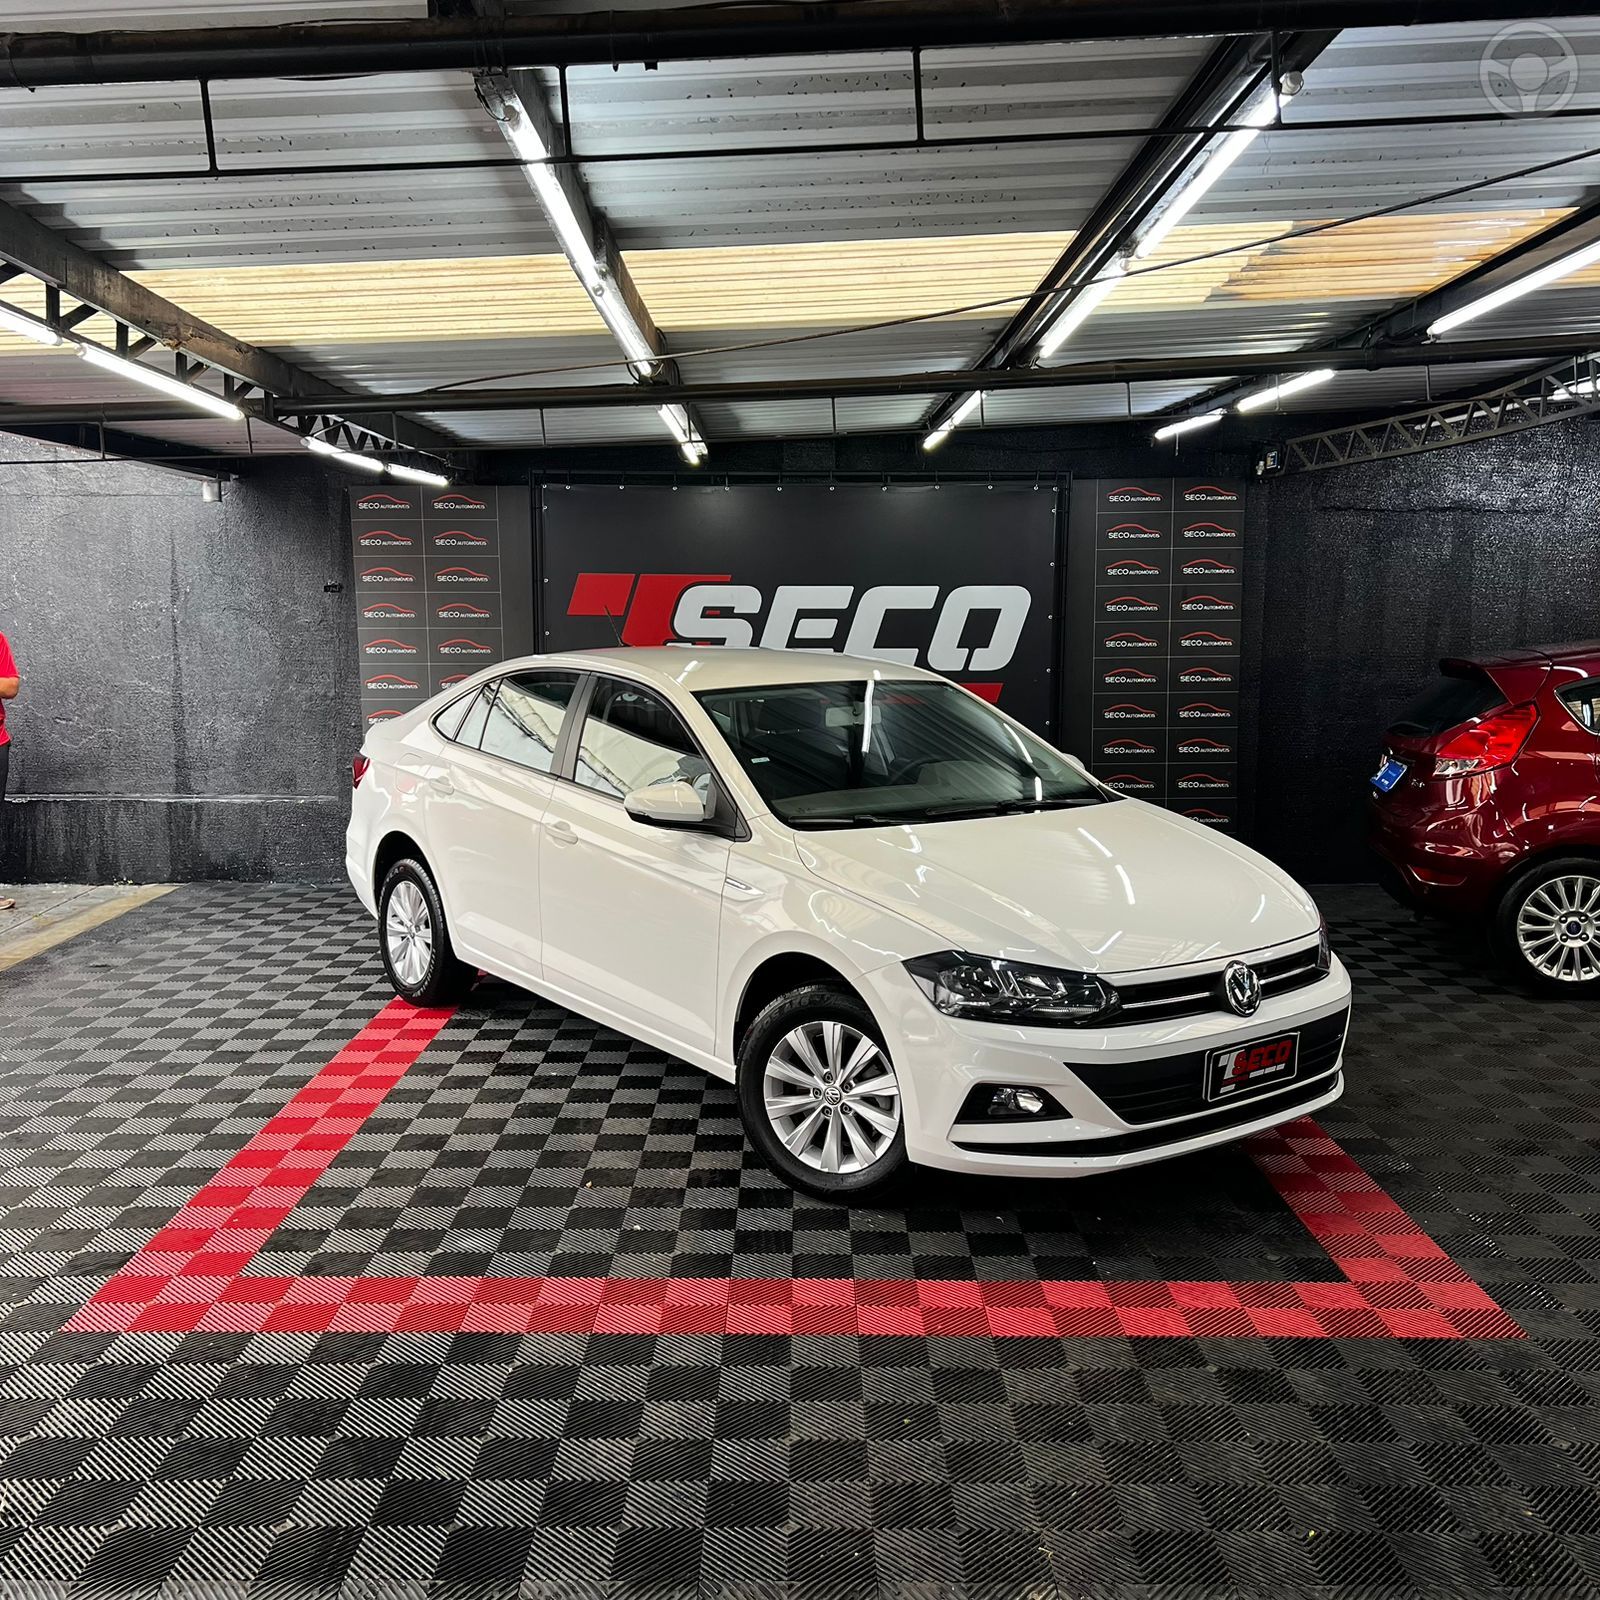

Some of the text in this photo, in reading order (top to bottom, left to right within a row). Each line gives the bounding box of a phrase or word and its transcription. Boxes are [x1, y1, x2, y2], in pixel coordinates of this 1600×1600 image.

[358, 502, 380, 510] SECO
[433, 502, 455, 510] SECO
[360, 538, 381, 546] SECO
[435, 538, 457, 546] SECO
[666, 585, 1032, 671] SECO
[367, 682, 389, 690] SECO
[1232, 1040, 1292, 1075] SECO
